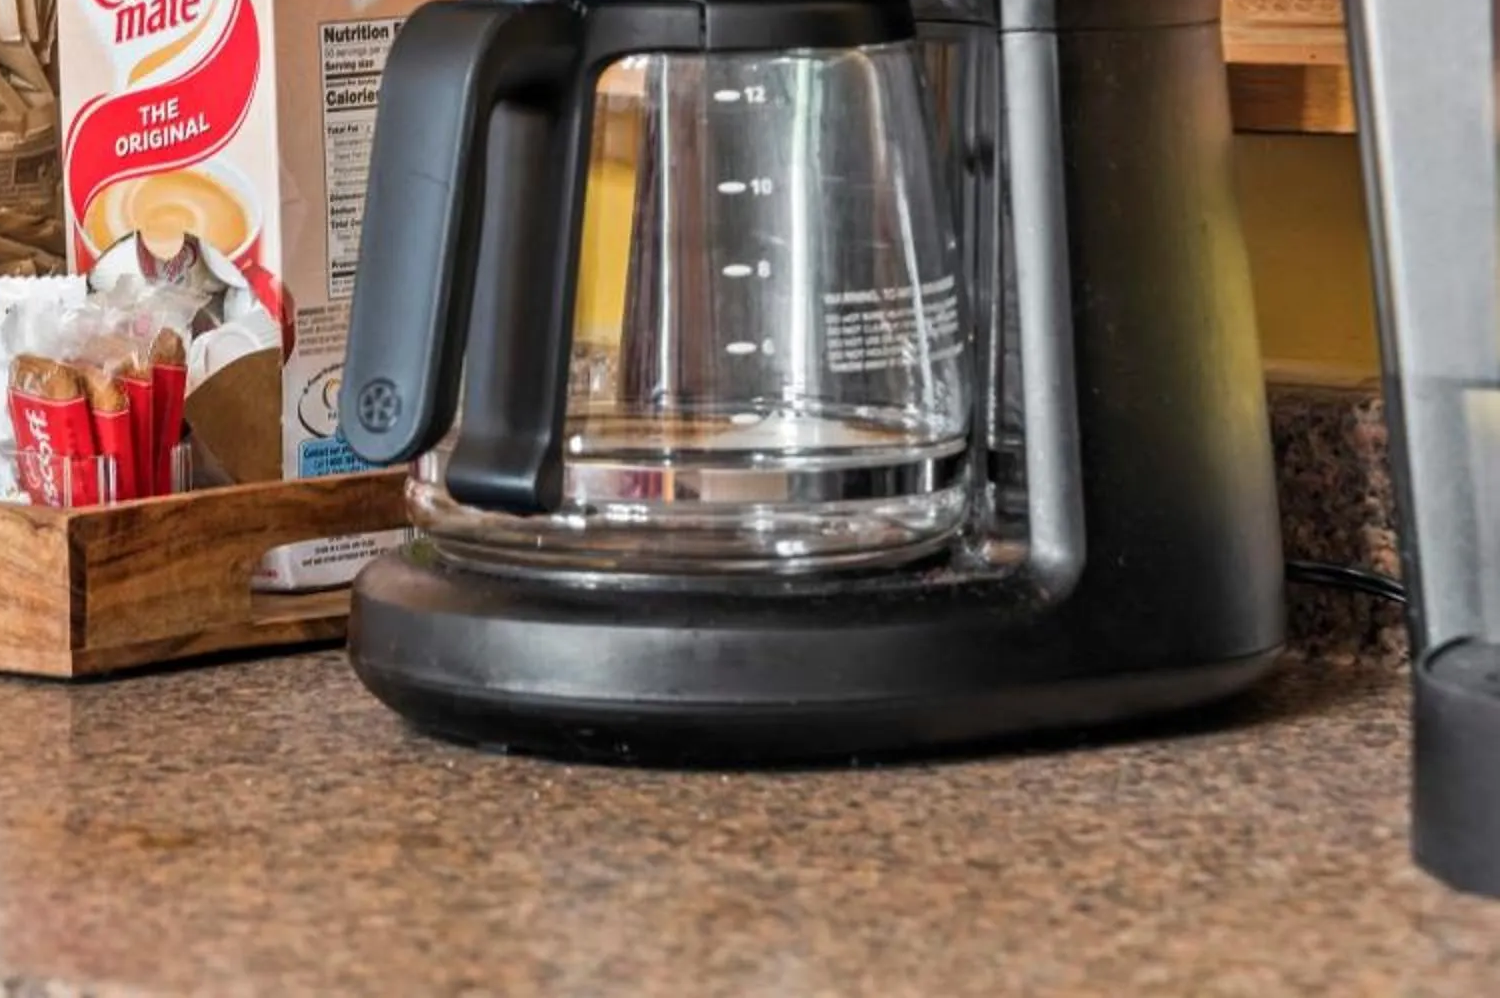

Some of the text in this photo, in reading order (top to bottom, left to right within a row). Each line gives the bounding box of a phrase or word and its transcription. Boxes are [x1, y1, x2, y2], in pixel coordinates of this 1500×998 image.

[323, 23, 390, 44] Nutrition
[325, 59, 357, 72] Serving
[744, 84, 766, 104] 12
[137, 96, 180, 127] THE
[114, 111, 212, 158] ORIGINAL
[750, 177, 773, 196] 10
